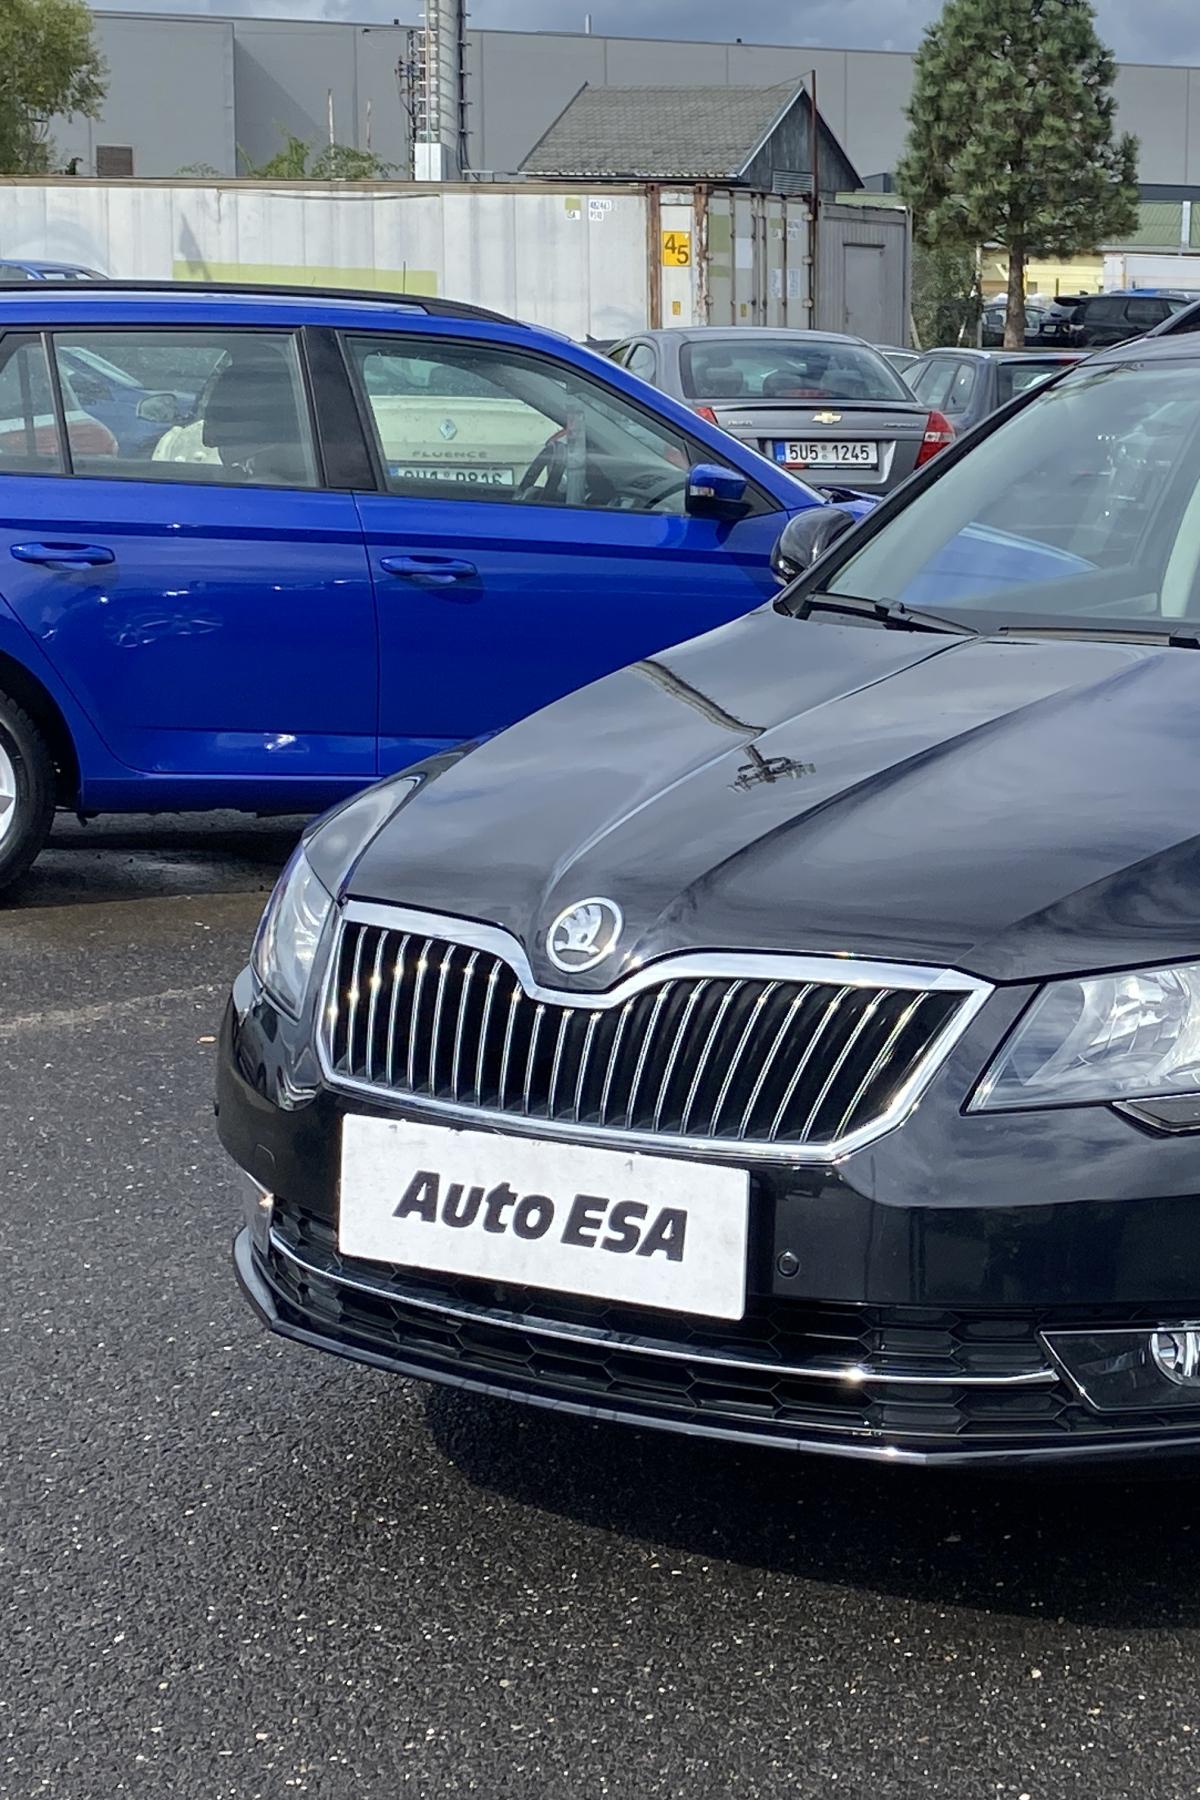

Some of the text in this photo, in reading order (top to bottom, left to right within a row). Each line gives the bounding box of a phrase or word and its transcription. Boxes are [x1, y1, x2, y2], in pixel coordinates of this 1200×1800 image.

[412, 450, 488, 459] FLUENCE
[789, 443, 869, 461] 5U5 1245
[392, 1169, 689, 1262] Auto ESA
